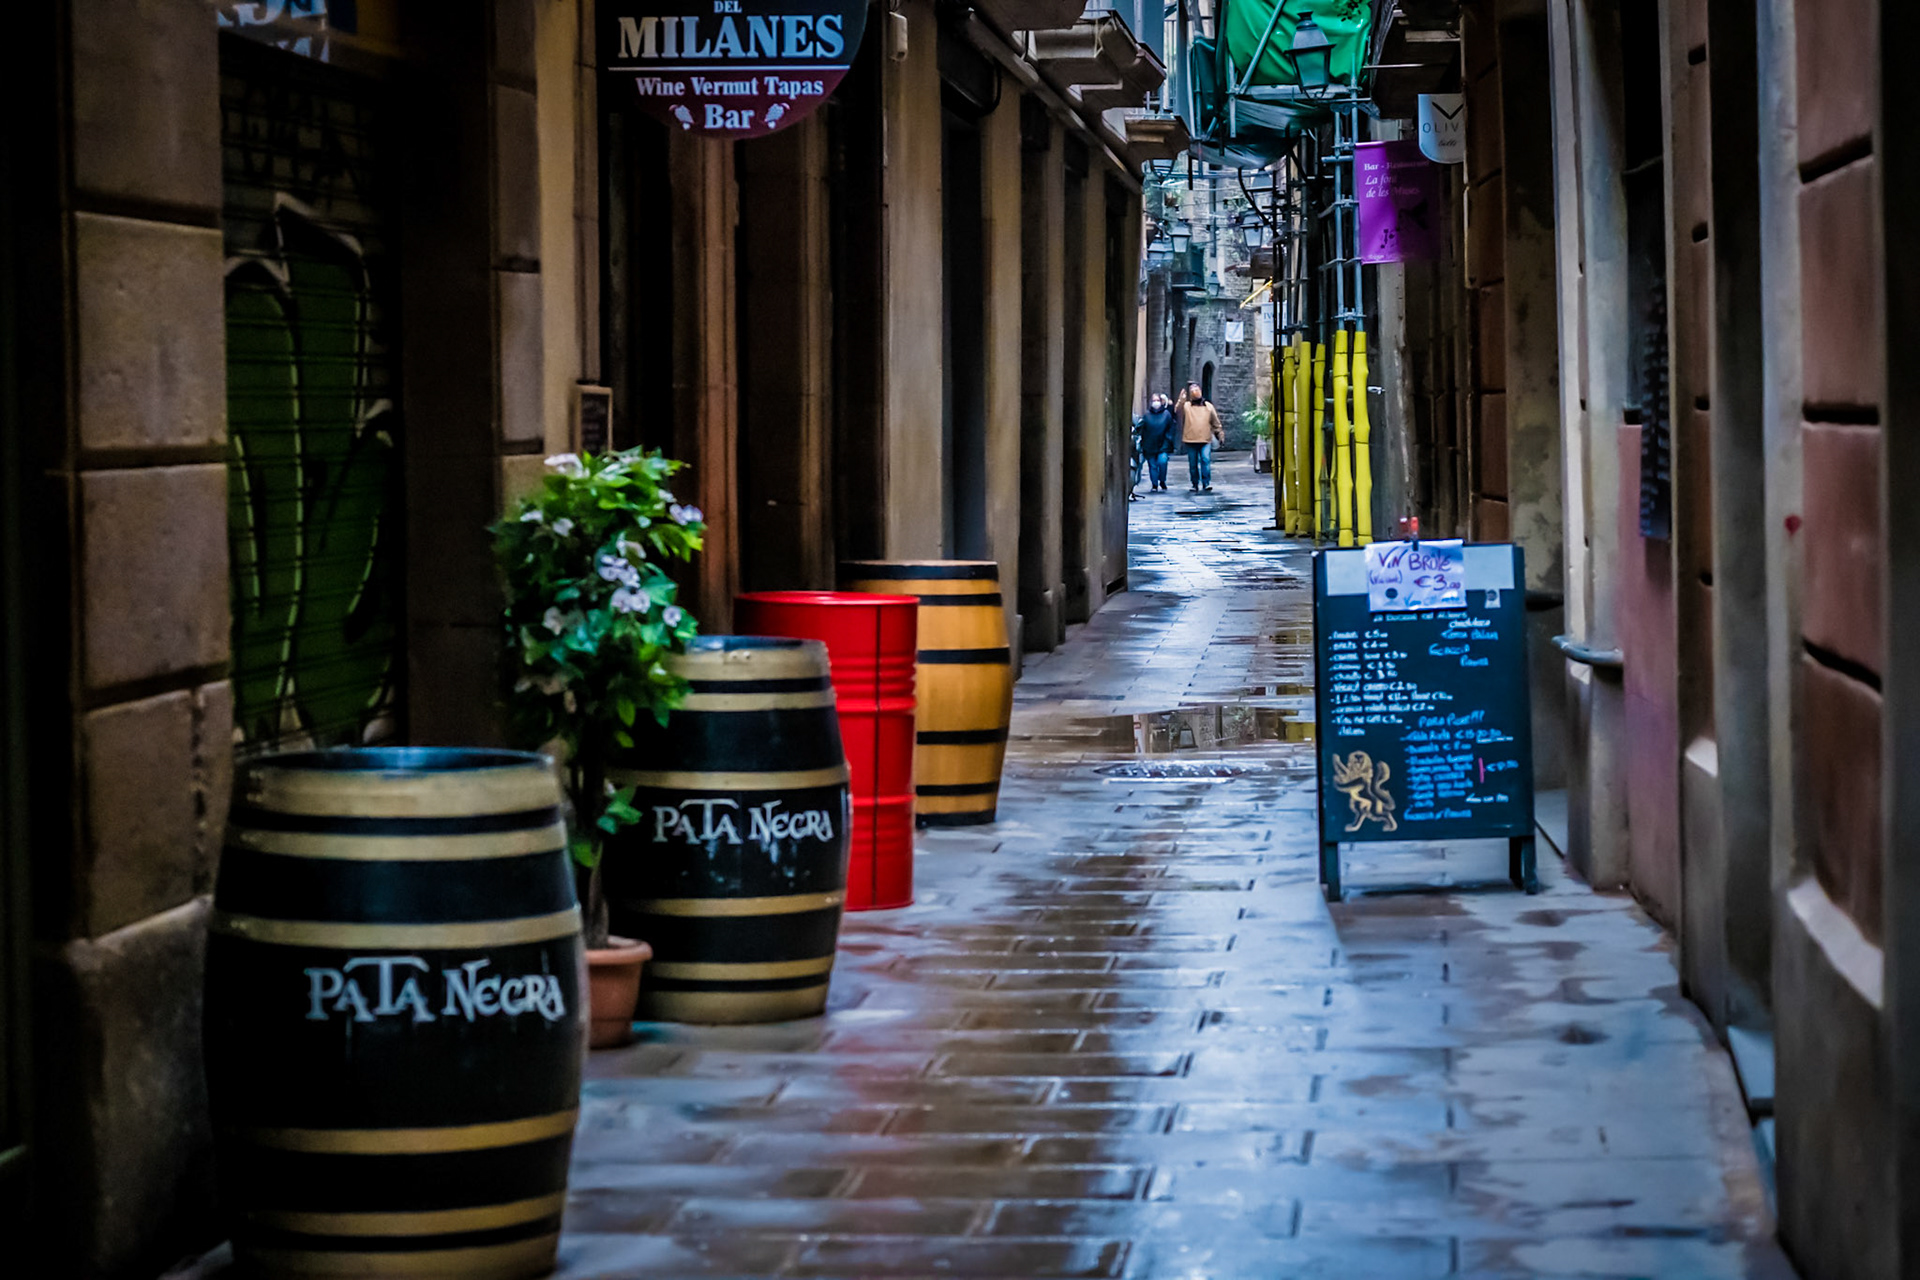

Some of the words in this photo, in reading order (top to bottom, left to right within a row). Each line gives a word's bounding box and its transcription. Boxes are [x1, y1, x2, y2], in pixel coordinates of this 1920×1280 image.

[714, 0, 742, 13] DEL
[618, 14, 845, 58] MILANES
[636, 77, 685, 96] Wine
[690, 77, 758, 96] Vermut
[764, 76, 823, 100] Tapas
[704, 104, 755, 129] Bar
[1364, 163, 1378, 171] Bar
[1365, 175, 1378, 185] La
